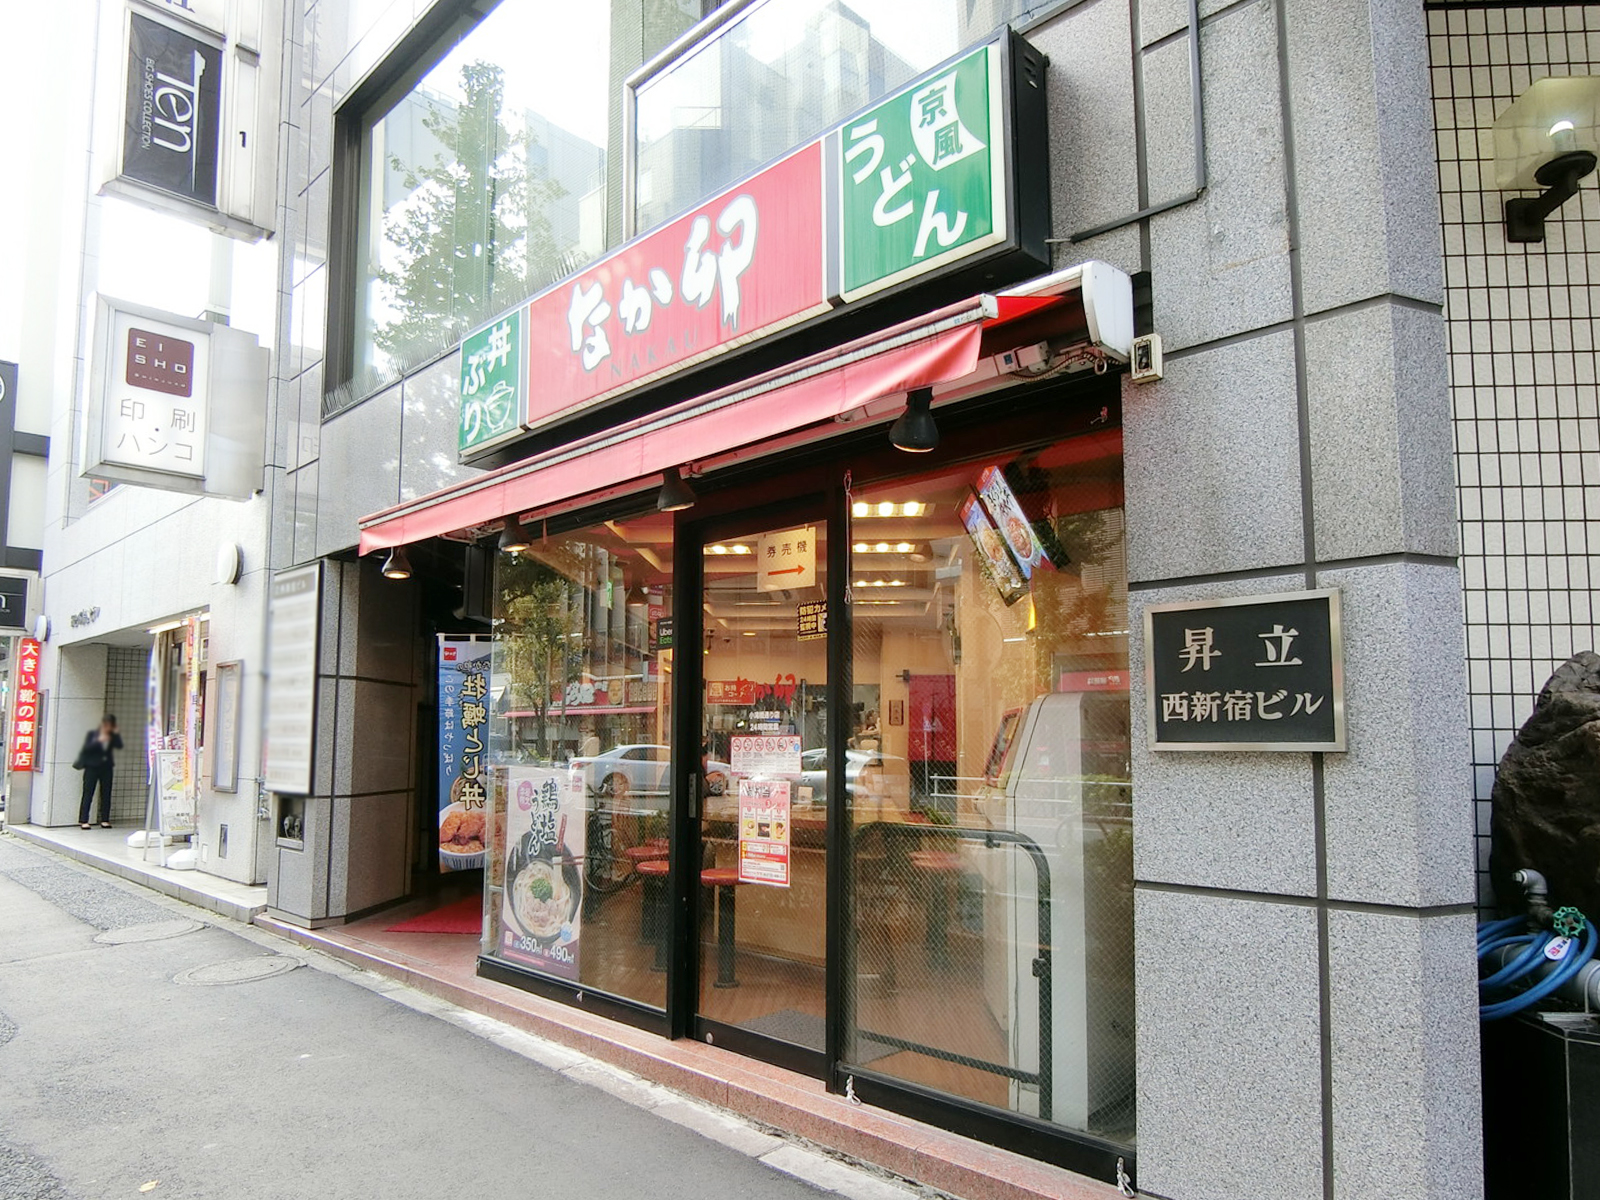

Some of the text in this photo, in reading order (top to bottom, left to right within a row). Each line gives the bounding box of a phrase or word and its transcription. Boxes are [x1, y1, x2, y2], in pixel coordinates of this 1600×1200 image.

[143, 72, 154, 101] SHOES
[141, 100, 153, 150] COLLECTION
[153, 50, 206, 191] Ten
[918, 87, 963, 166] 京風
[844, 116, 969, 258] うどん
[567, 194, 758, 371] なか卯
[610, 327, 698, 378] NAKAU
[117, 432, 193, 462] ハンコ
[766, 540, 808, 559] 券売機
[14, 642, 39, 768] 大きい靴の専門店
[1160, 689, 1325, 723] 西新宿ビル
